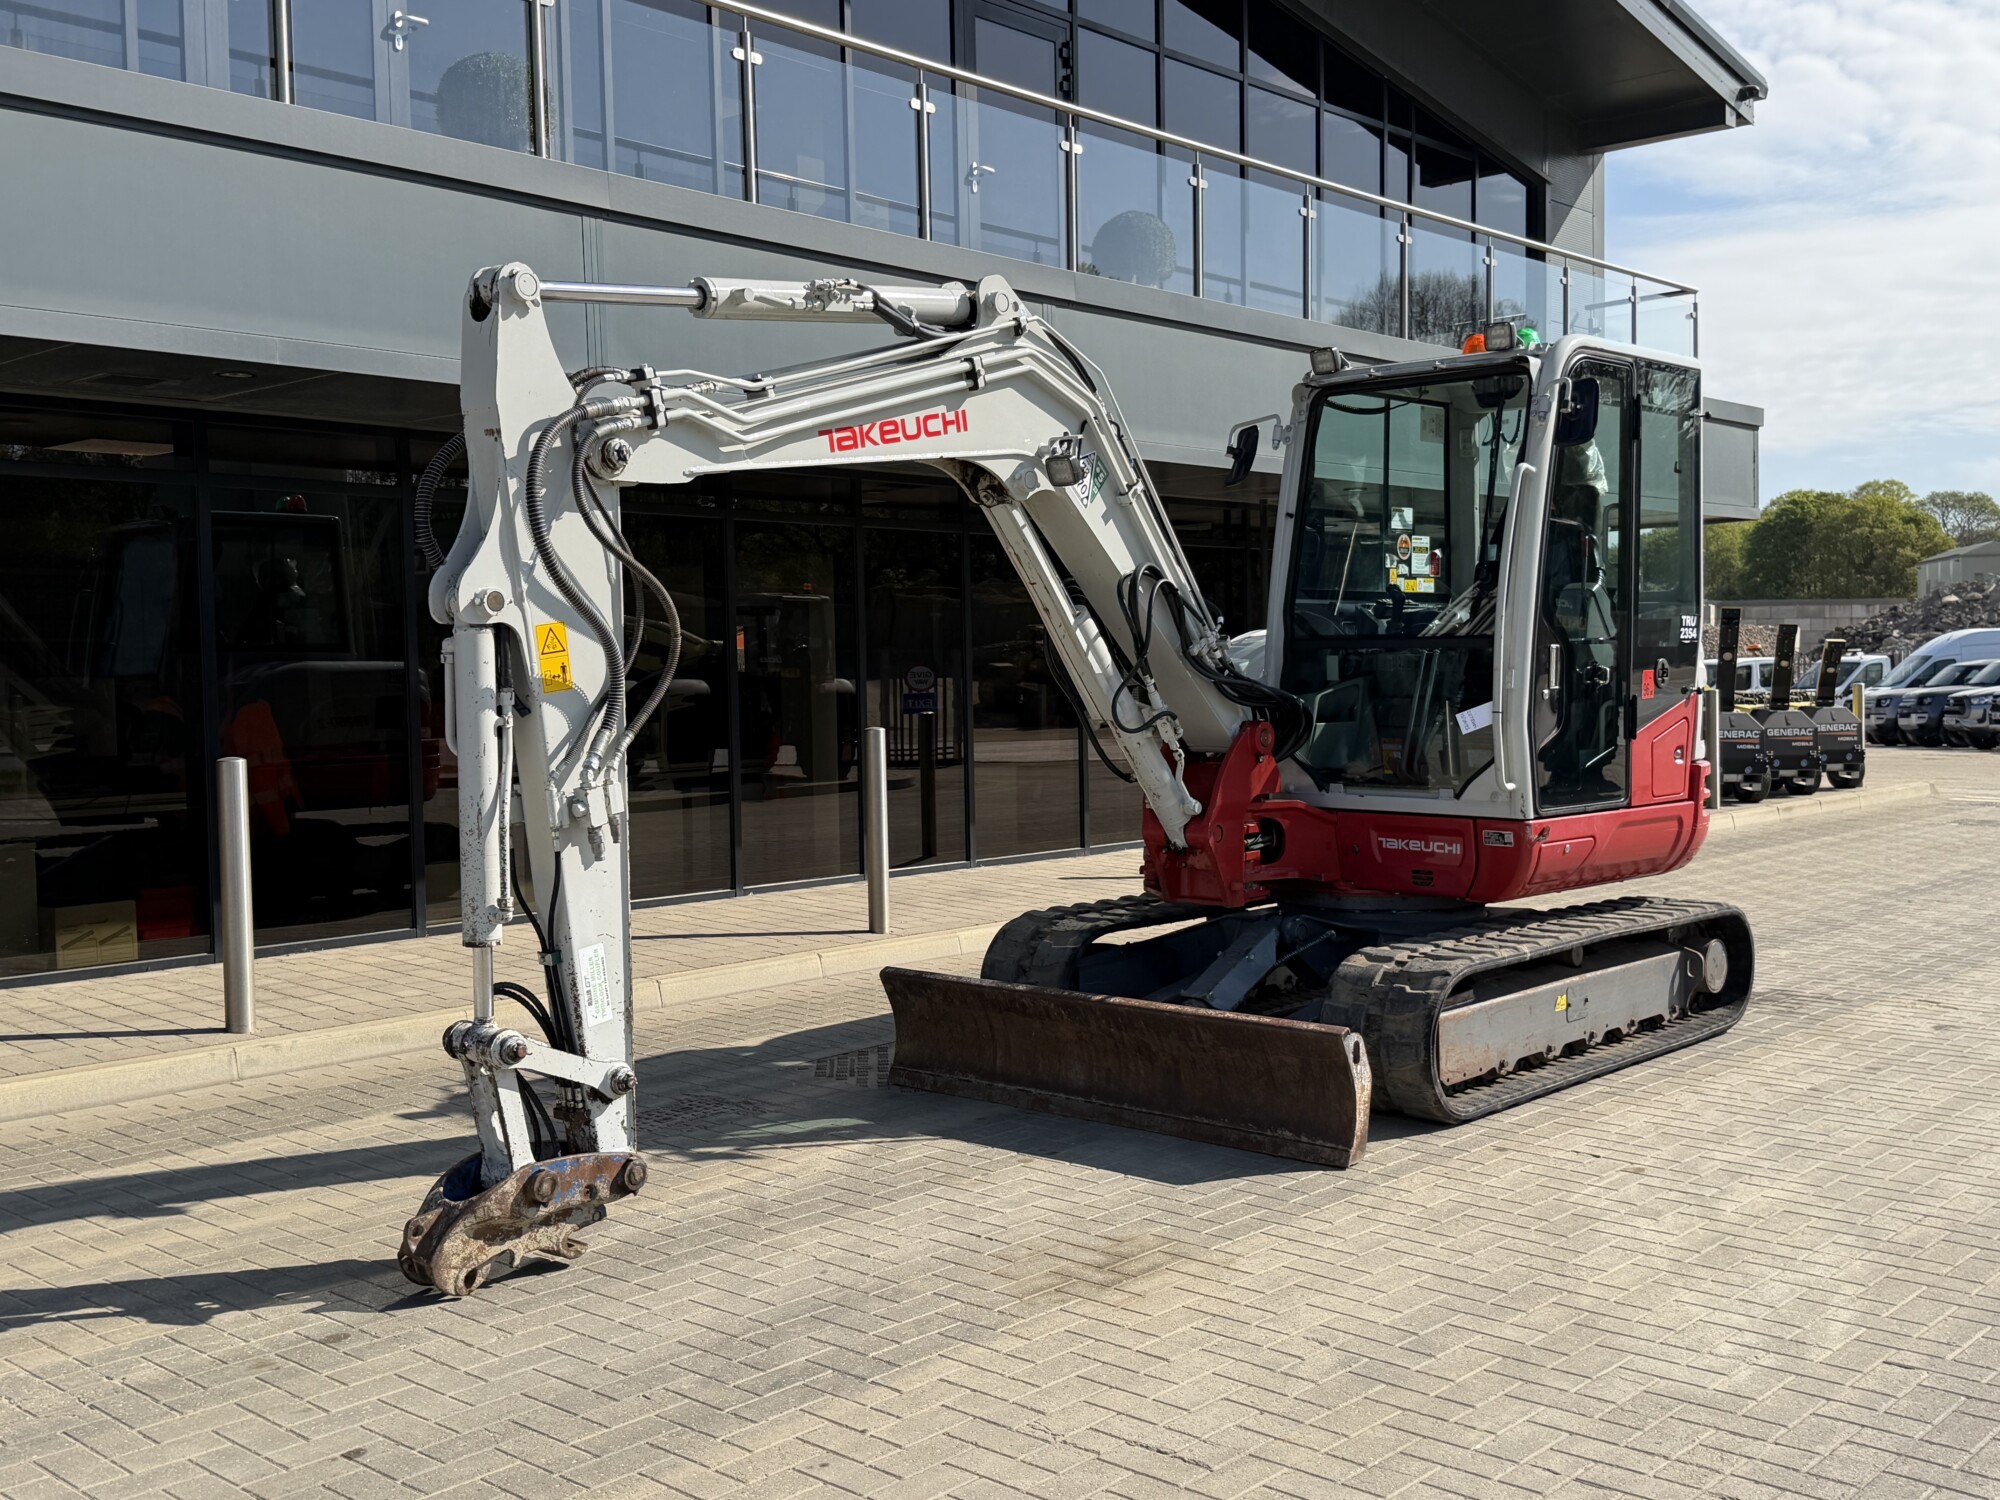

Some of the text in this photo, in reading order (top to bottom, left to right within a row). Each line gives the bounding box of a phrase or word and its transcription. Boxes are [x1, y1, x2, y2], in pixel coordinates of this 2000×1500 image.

[817, 409, 969, 453] TAKEUCHI
[1681, 615, 1697, 627] TRU
[1680, 627, 1697, 639] 2354
[1718, 730, 1760, 739] ENERAC
[1766, 728, 1813, 737] GENERAC
[1377, 836, 1461, 855] TAKEUCHI
[588, 956, 596, 982] MILLER
[593, 948, 602, 981] COUPLER
[592, 983, 600, 1014] GENUINE
